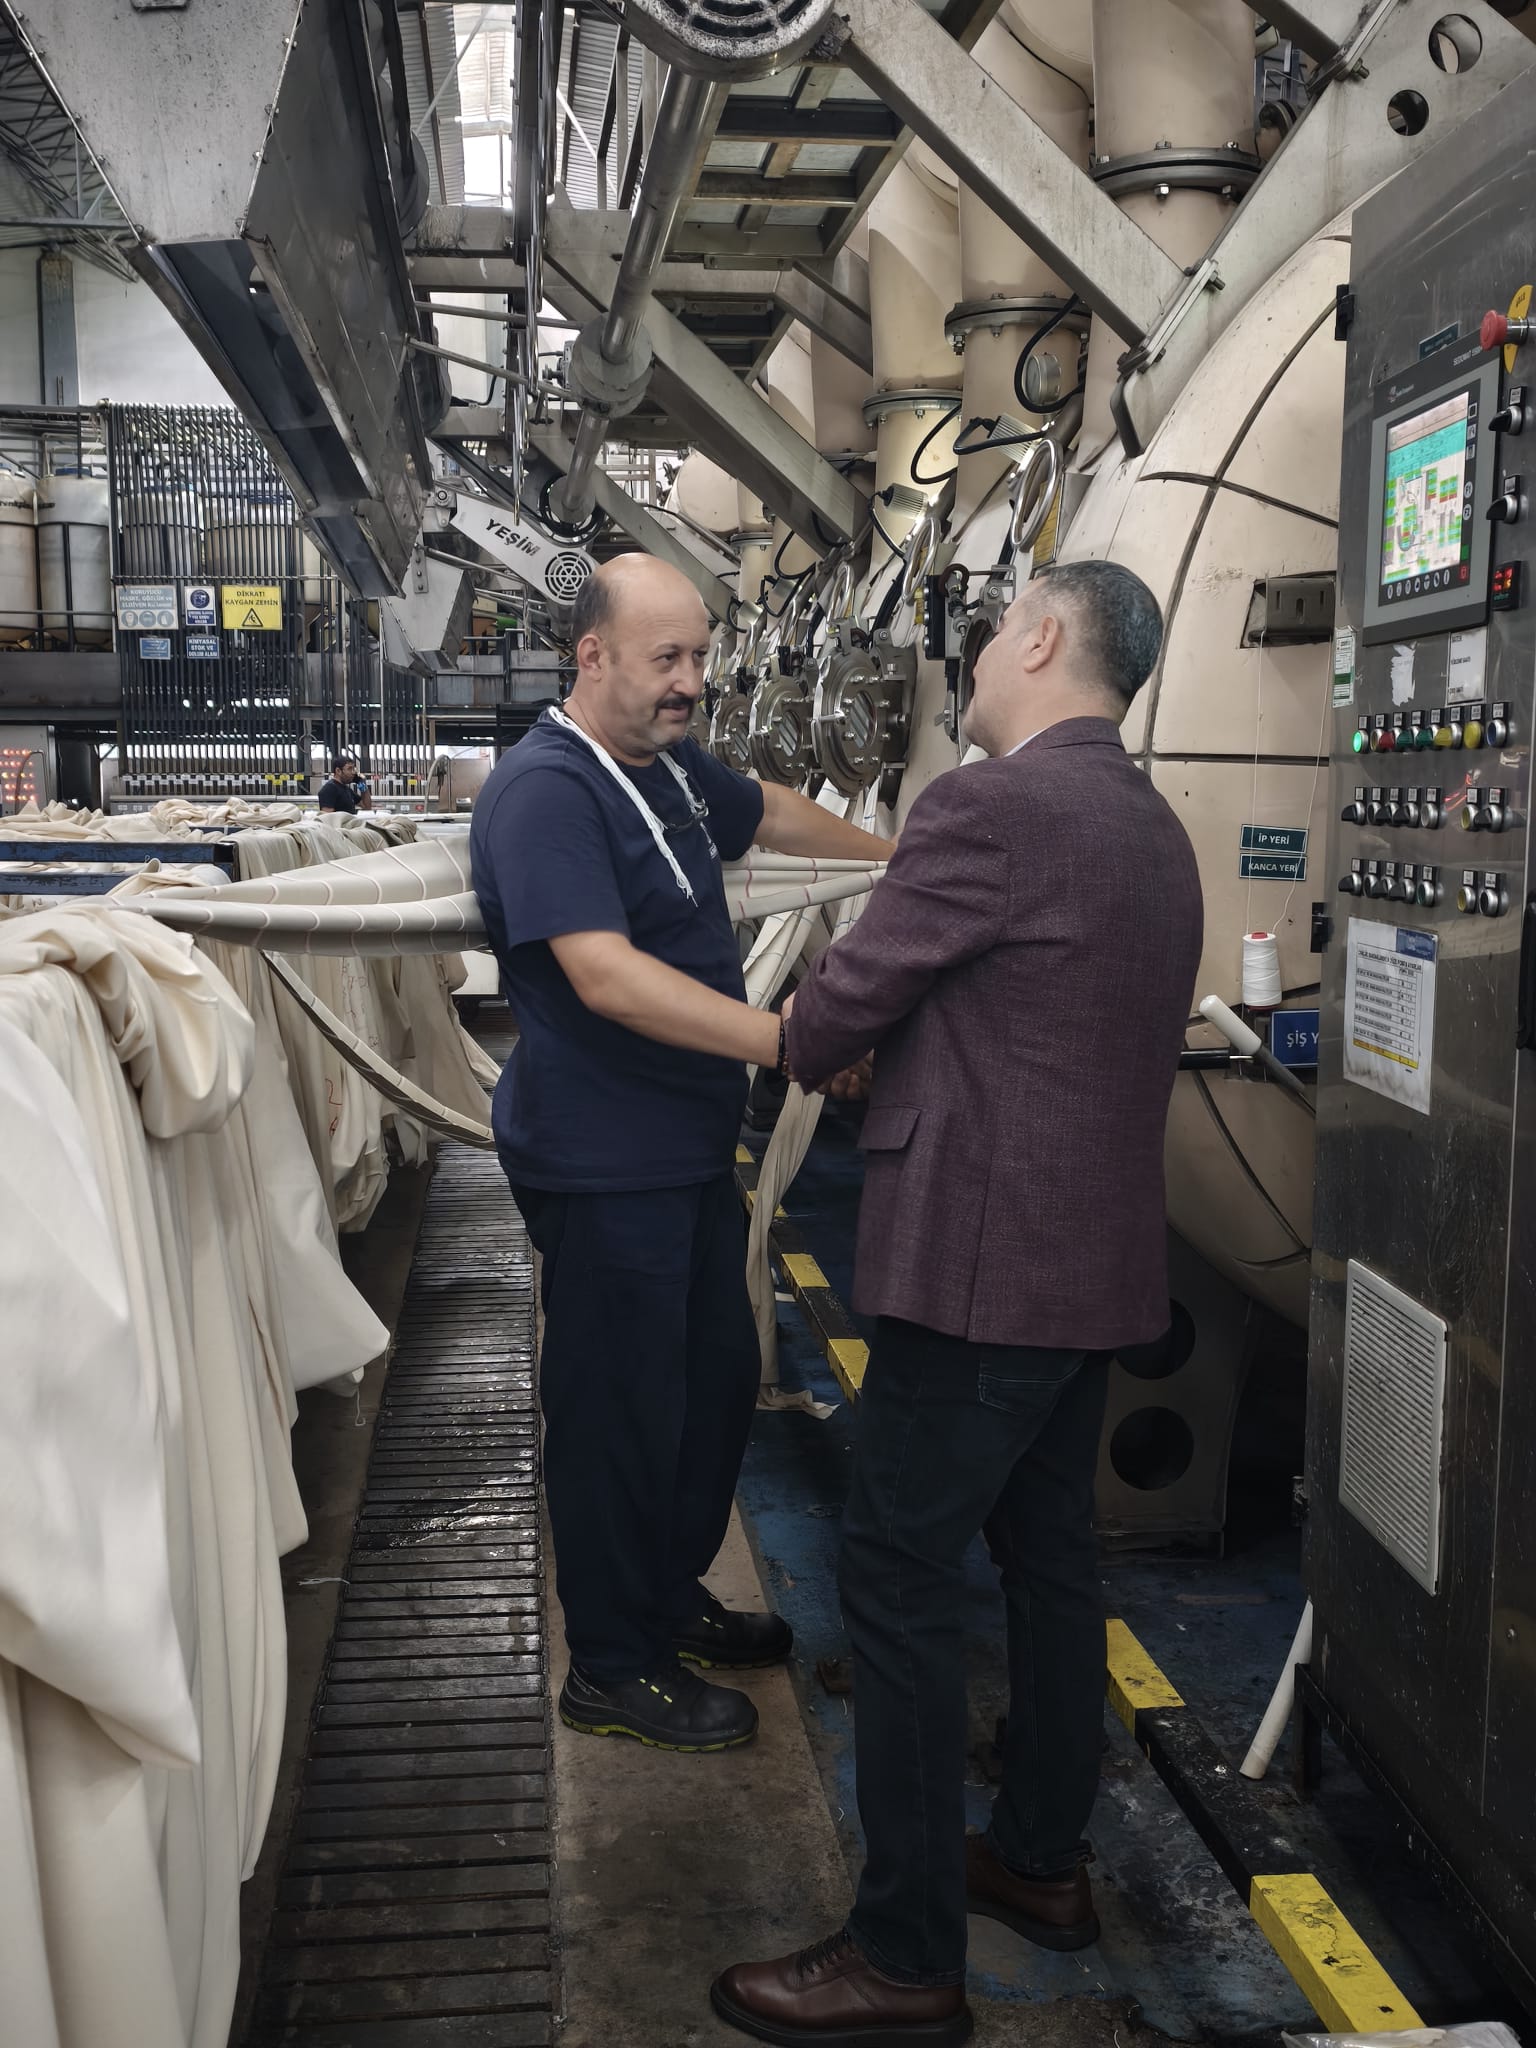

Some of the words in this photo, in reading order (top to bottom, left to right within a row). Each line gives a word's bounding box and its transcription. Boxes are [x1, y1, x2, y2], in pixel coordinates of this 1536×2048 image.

[485, 518, 541, 556] YEŞİM
[1258, 832, 1267, 843] İP
[1269, 835, 1290, 845] YERİ
[1248, 862, 1278, 871] KANCA
[1287, 1030, 1307, 1047] ŞİŞ
